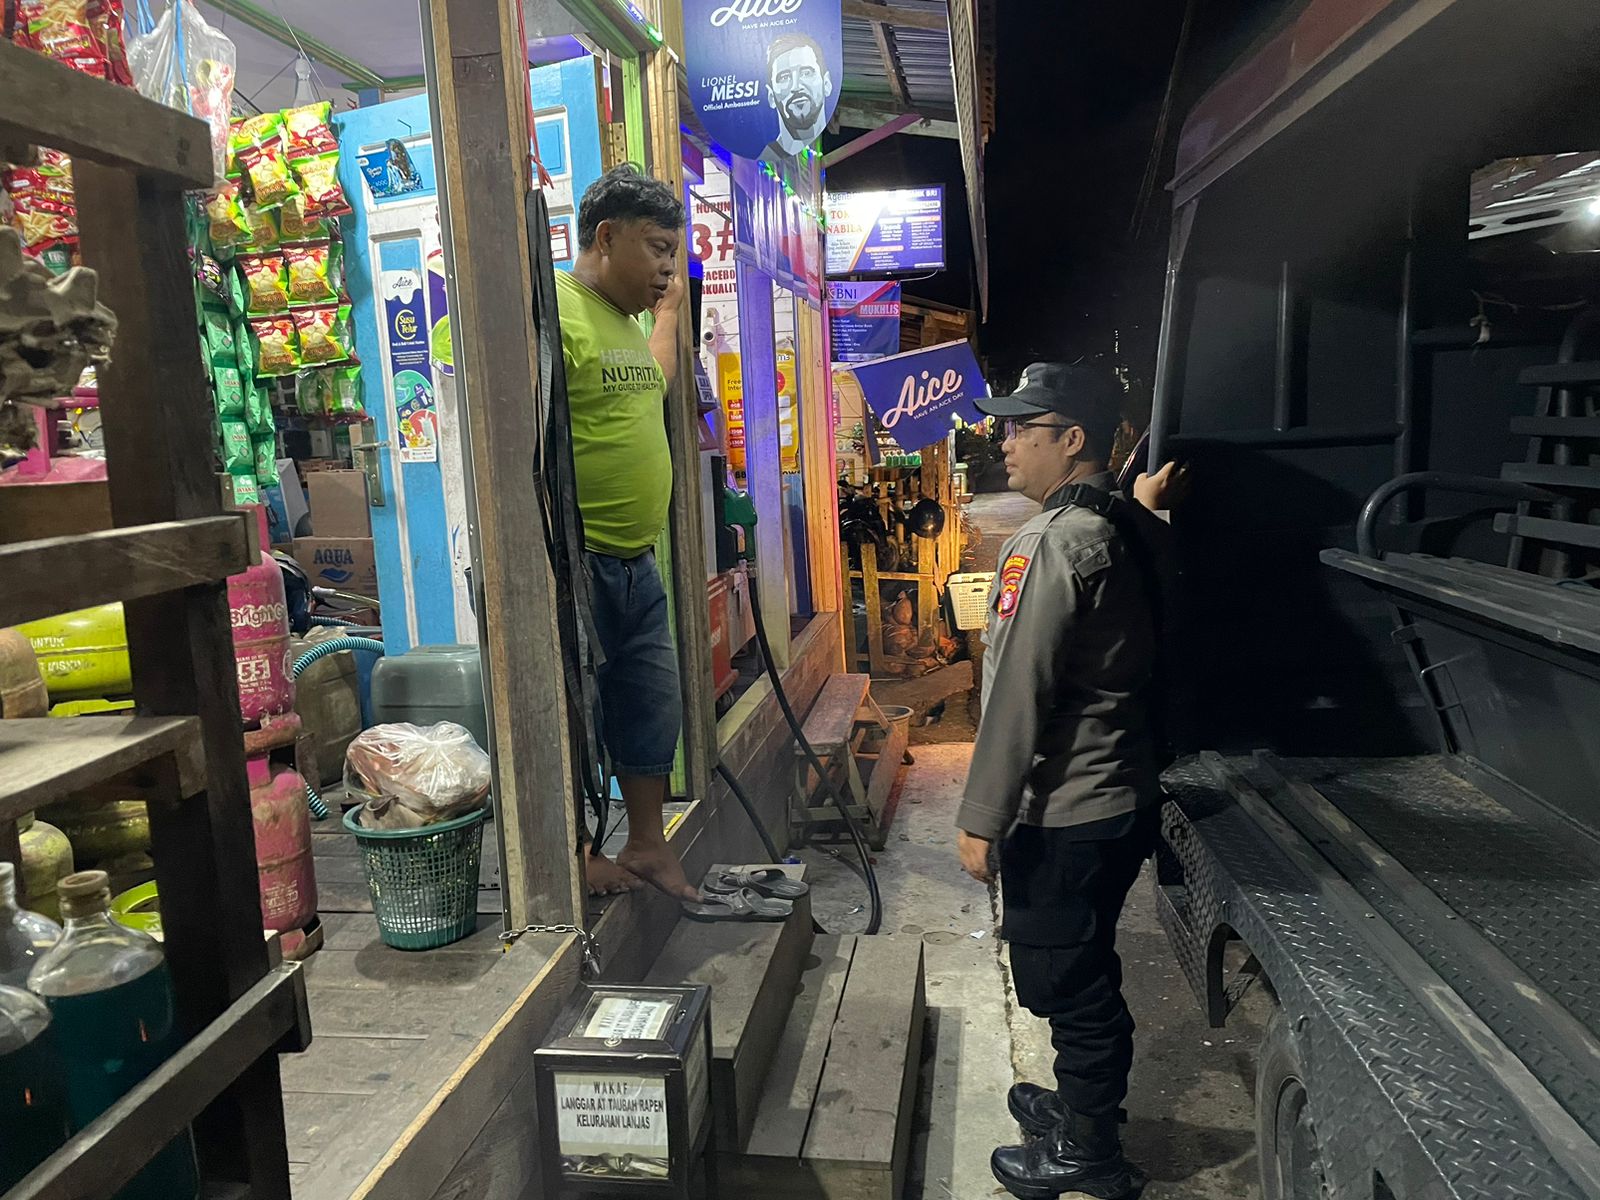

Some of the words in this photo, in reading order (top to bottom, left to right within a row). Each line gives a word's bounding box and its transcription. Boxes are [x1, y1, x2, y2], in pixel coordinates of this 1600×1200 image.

[701, 74, 737, 88] LIONEL
[711, 80, 759, 102] MESSI
[703, 102, 723, 111] Official
[724, 99, 760, 108] Ambassador
[704, 269, 736, 281] ACEBO
[392, 276, 414, 290] Aice
[836, 288, 857, 299] BNI
[860, 303, 899, 315] MUKHLIS
[399, 315, 415, 325] Susu
[401, 324, 418, 334] Telur
[603, 384, 616, 392] MY
[618, 383, 635, 391] GUIDE
[882, 369, 963, 429] Aice
[913, 409, 928, 420] HAVE
[929, 405, 938, 413] AN
[938, 398, 952, 408] AICE
[952, 391, 964, 401] DAY
[313, 549, 354, 567] AQUA
[561, 1096, 596, 1110] LANGGAR
[597, 1097, 605, 1111] AT
[608, 1097, 637, 1112] TAUBAH
[577, 1114, 620, 1128] KELURAHAN
[622, 1115, 651, 1130] LANJAS
